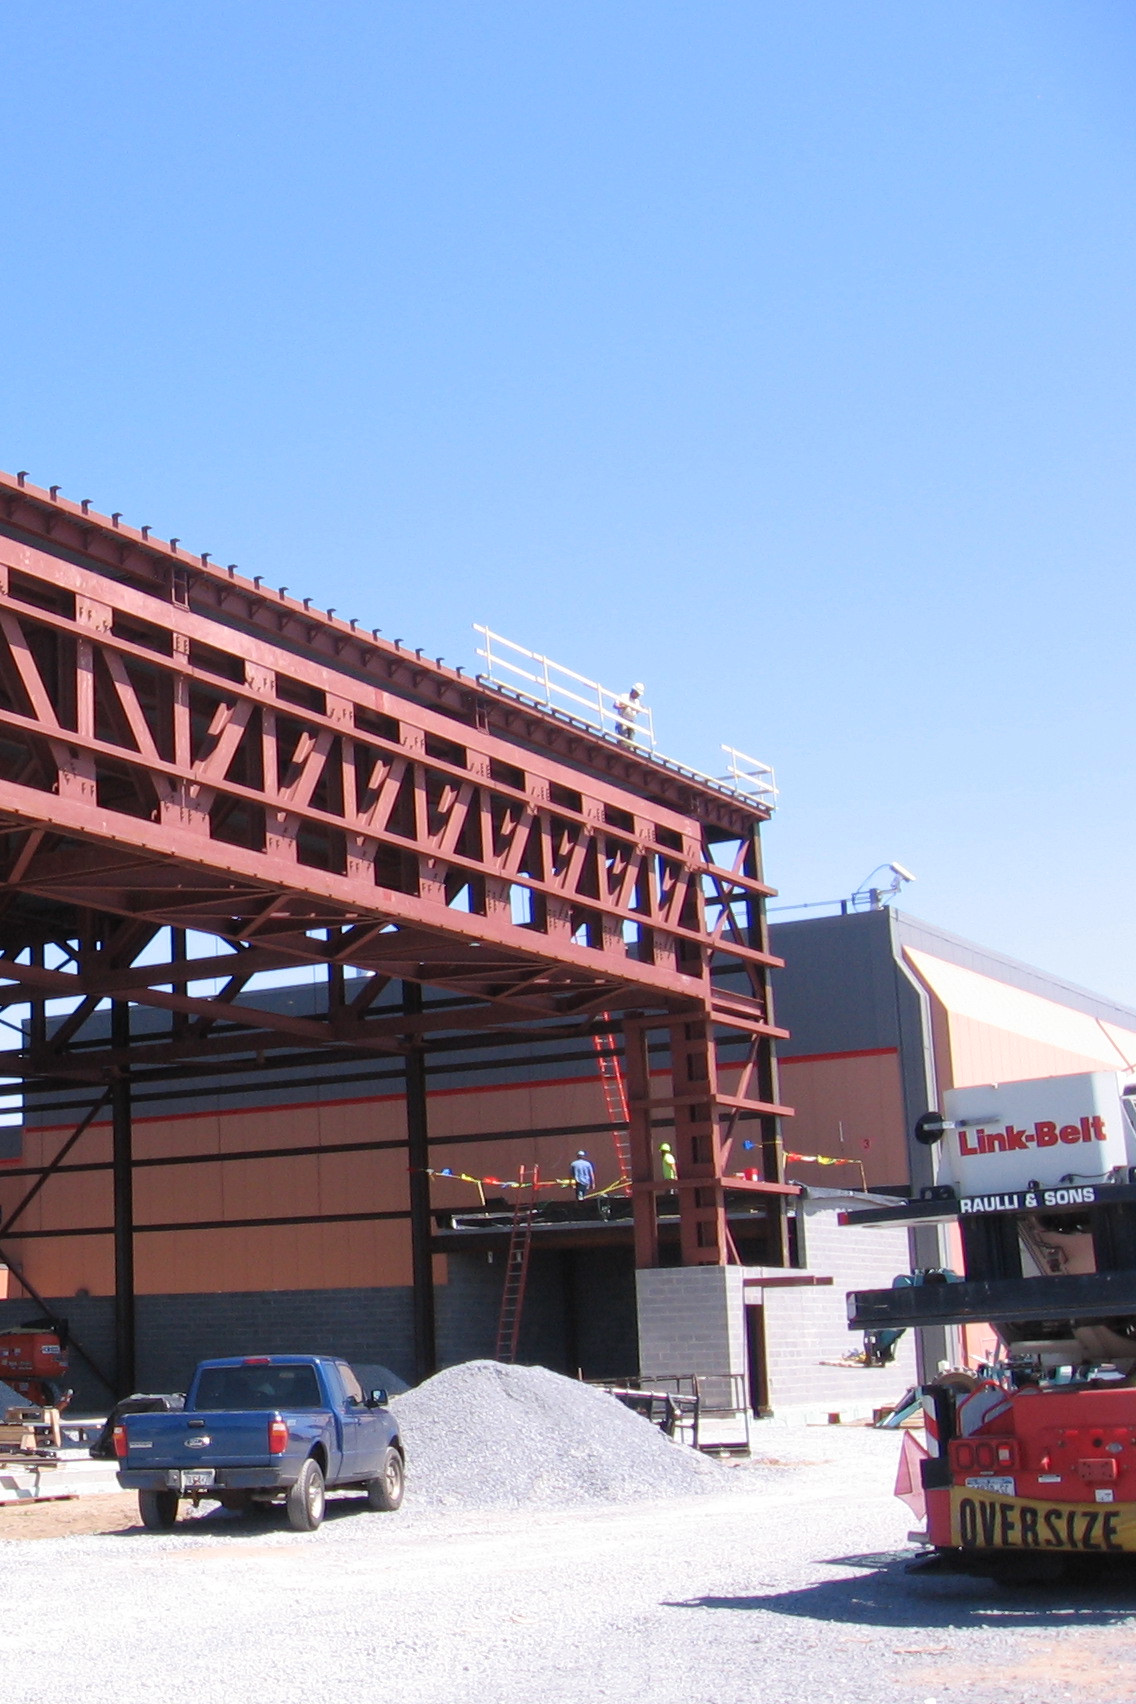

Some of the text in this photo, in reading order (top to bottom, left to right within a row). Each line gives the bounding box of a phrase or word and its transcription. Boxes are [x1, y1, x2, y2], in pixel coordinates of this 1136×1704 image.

[958, 1115, 1107, 1156] Link-Belt
[960, 1187, 1095, 1214] RAULLI & SONS
[960, 1498, 1124, 1551] OVERSIZE
